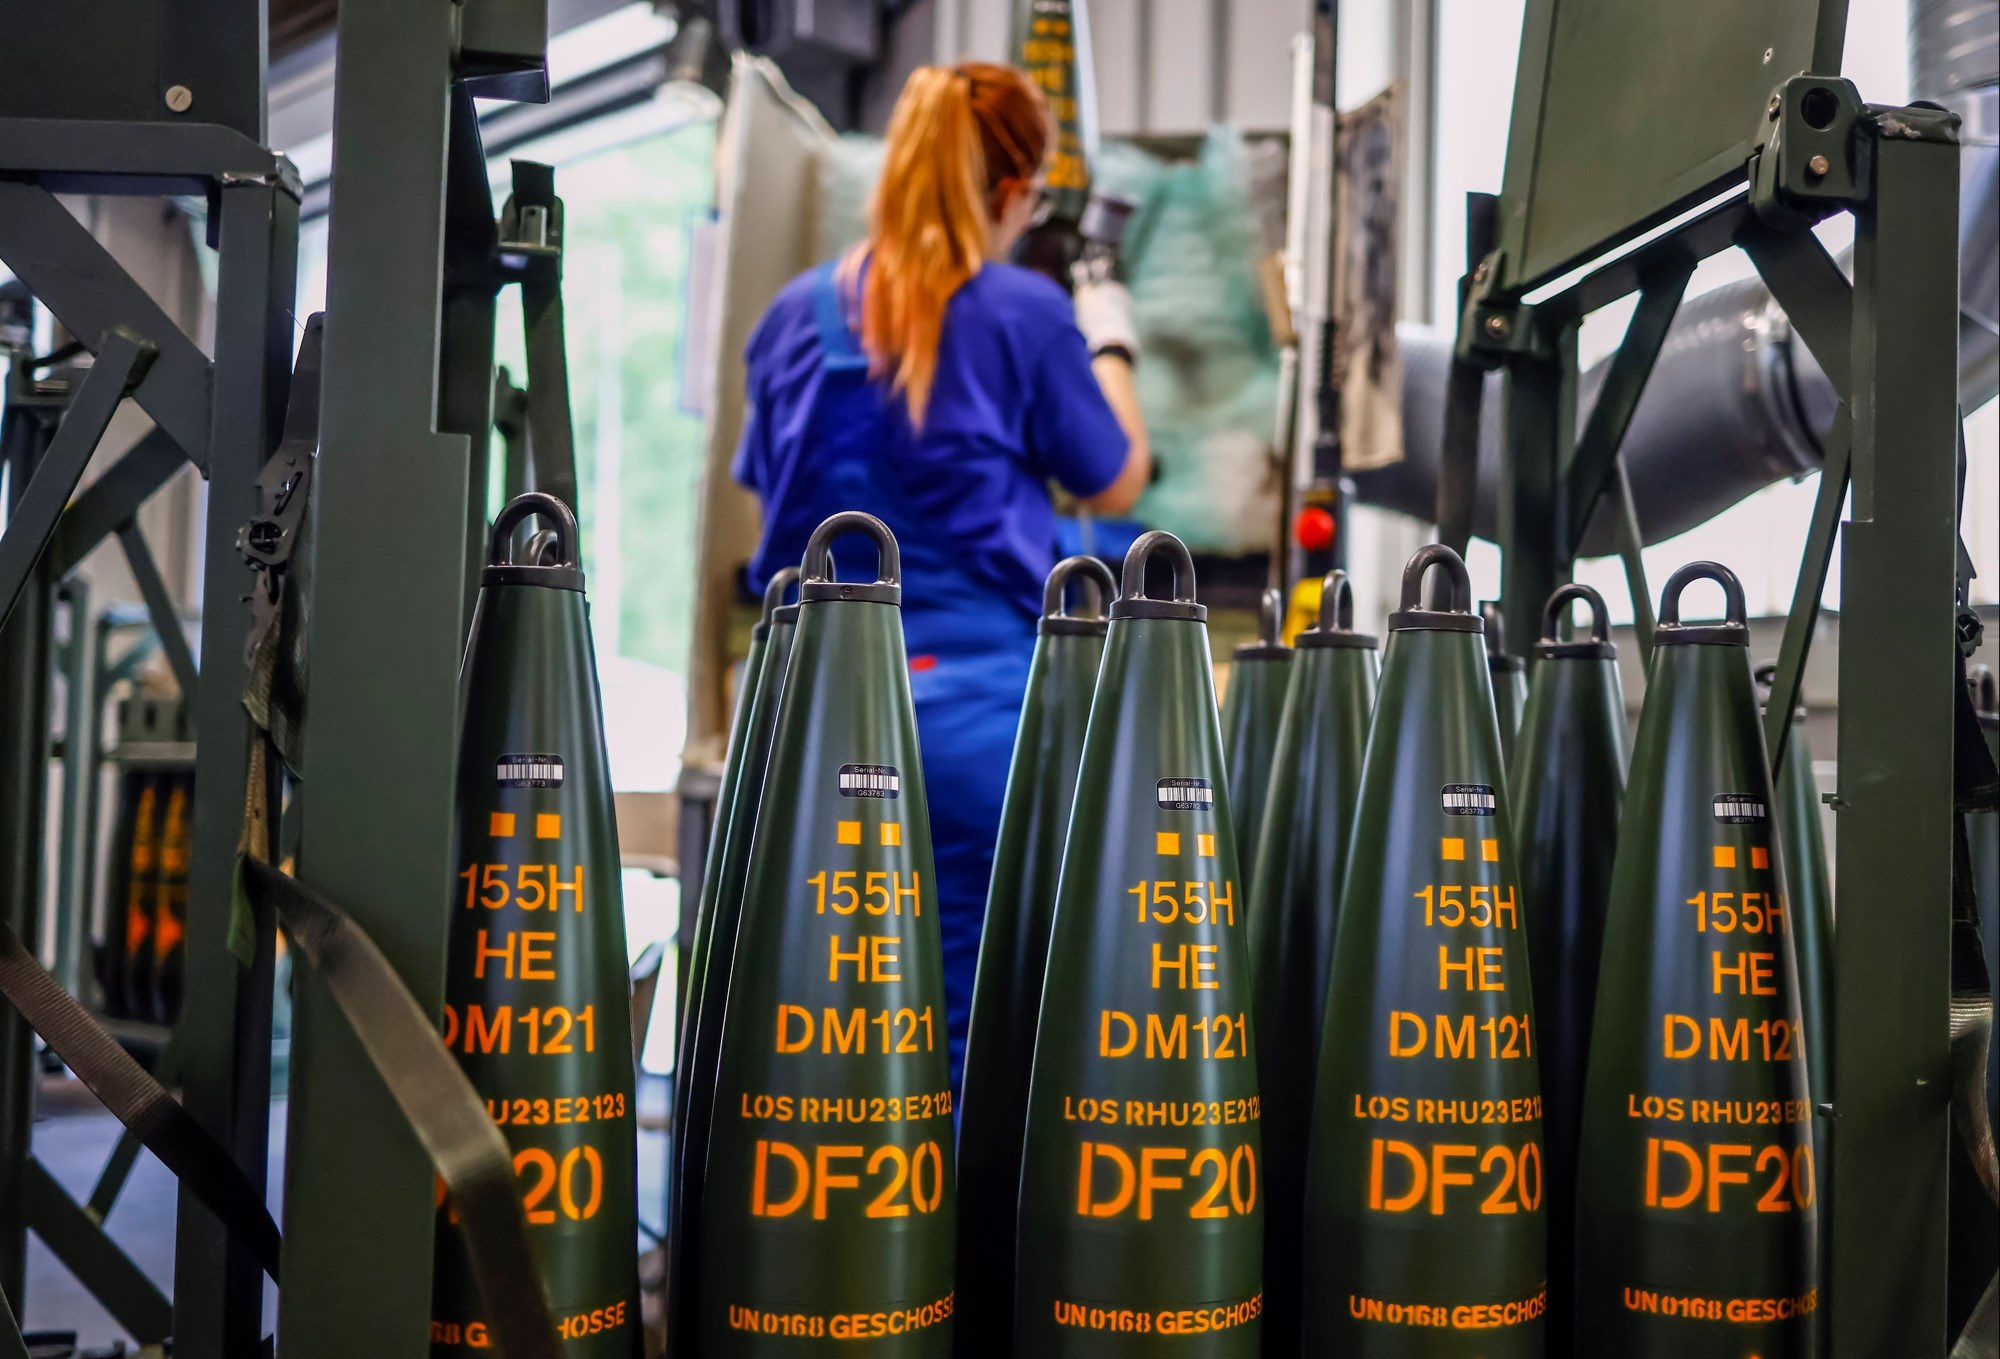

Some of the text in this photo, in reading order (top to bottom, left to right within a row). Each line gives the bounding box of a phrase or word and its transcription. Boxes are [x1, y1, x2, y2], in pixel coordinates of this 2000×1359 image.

[854, 766, 888, 774] Serial-Nr.
[1175, 802, 1201, 810] G63782
[460, 863, 585, 912] 155H
[807, 870, 921, 917] 155H
[1127, 879, 1235, 927] 155H
[1413, 884, 1517, 930] 155H
[1686, 891, 1787, 934] 155H
[475, 930, 557, 980] HE
[828, 935, 902, 983] HE
[1151, 942, 1221, 990] HE
[1438, 945, 1506, 992] HE
[1712, 951, 1777, 995] HE
[775, 1004, 934, 1055] DM121
[1098, 1009, 1247, 1060] DM121
[1388, 1011, 1531, 1060] DM121
[1663, 1014, 1803, 1062] DM121
[487, 1092, 625, 1128] U23E2123
[741, 1093, 794, 1121] LOS
[1064, 1096, 1119, 1124] LOS
[1354, 1094, 1409, 1122] LOS
[1628, 1094, 1684, 1121] LOS
[435, 1145, 604, 1224] 20
[750, 1139, 943, 1221] DF20
[1076, 1140, 1257, 1221] DF20
[1367, 1138, 1542, 1216] DF20
[1643, 1137, 1815, 1212] DF20
[729, 1304, 759, 1332] UN
[762, 1312, 825, 1338] 0168
[1054, 1300, 1087, 1328] UN
[1089, 1309, 1151, 1333] 0168
[1349, 1291, 1546, 1329] UN 0168 GESCHOS
[1624, 1287, 1658, 1313] UN
[1660, 1295, 1723, 1320] 0168
